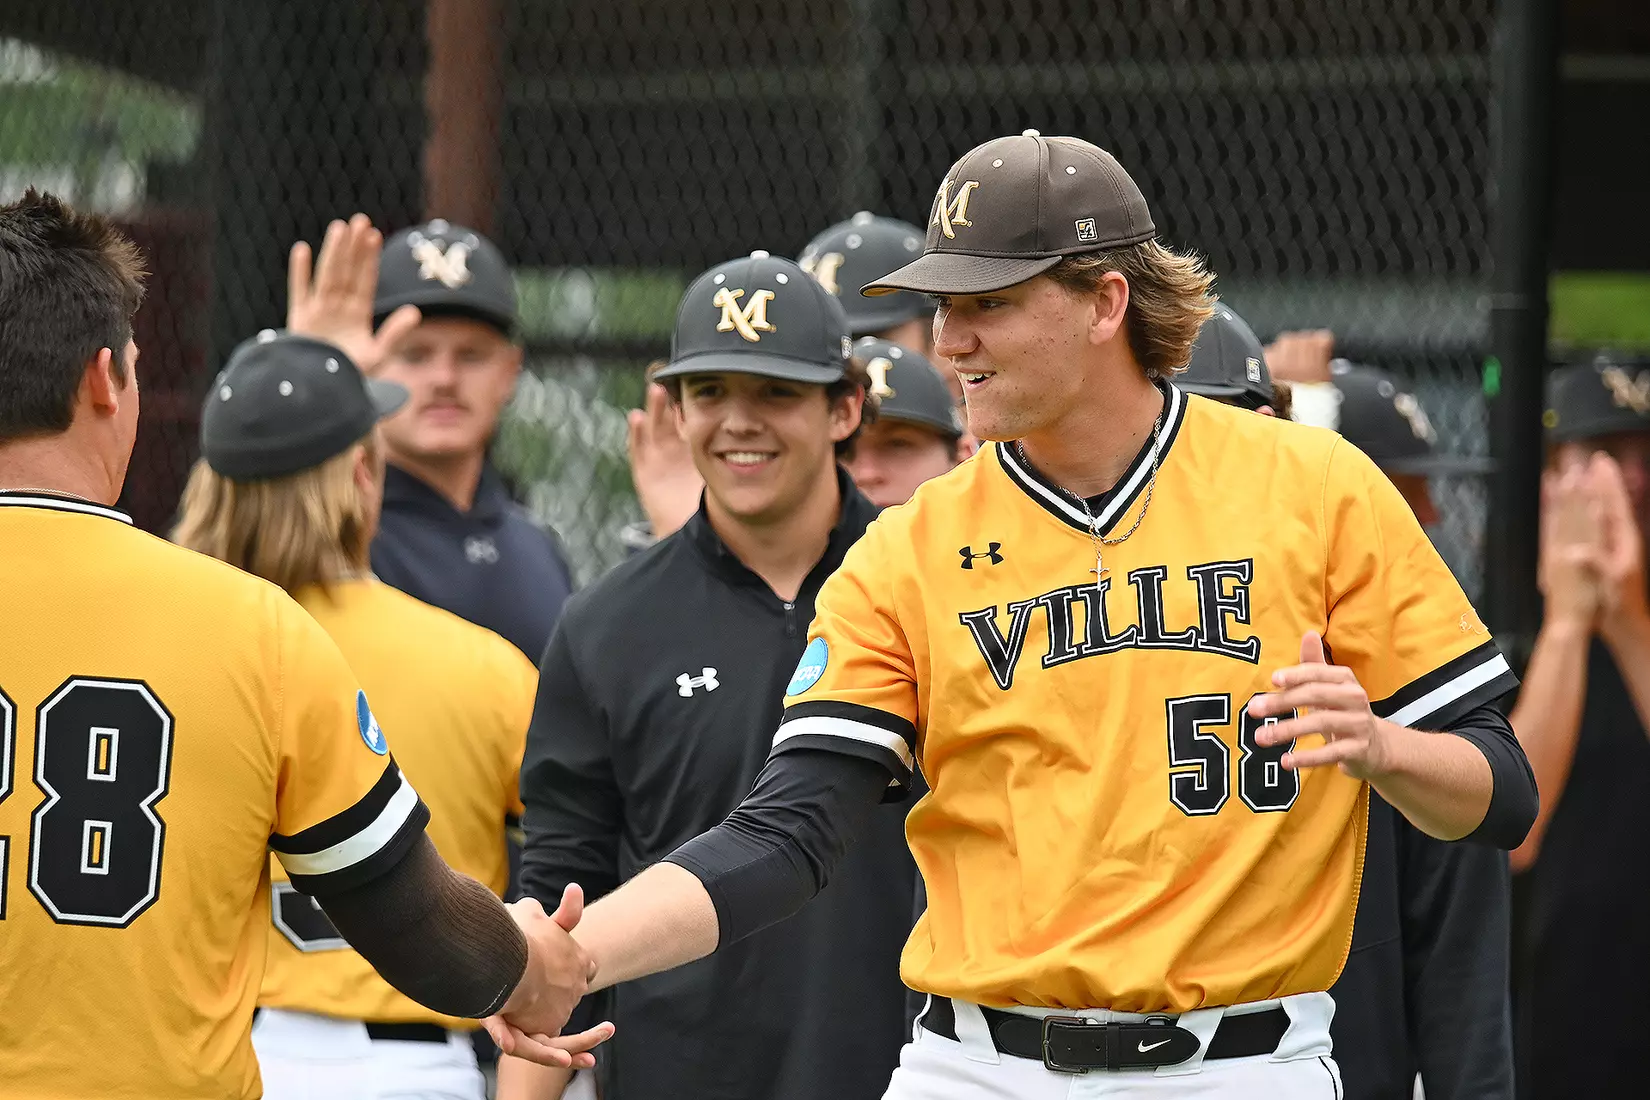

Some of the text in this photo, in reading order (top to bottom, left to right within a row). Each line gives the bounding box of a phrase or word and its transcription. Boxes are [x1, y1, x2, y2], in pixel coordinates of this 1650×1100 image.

[958, 558, 1261, 691] VILLE
[0, 674, 175, 929] 8
[1165, 693, 1300, 816] 58
